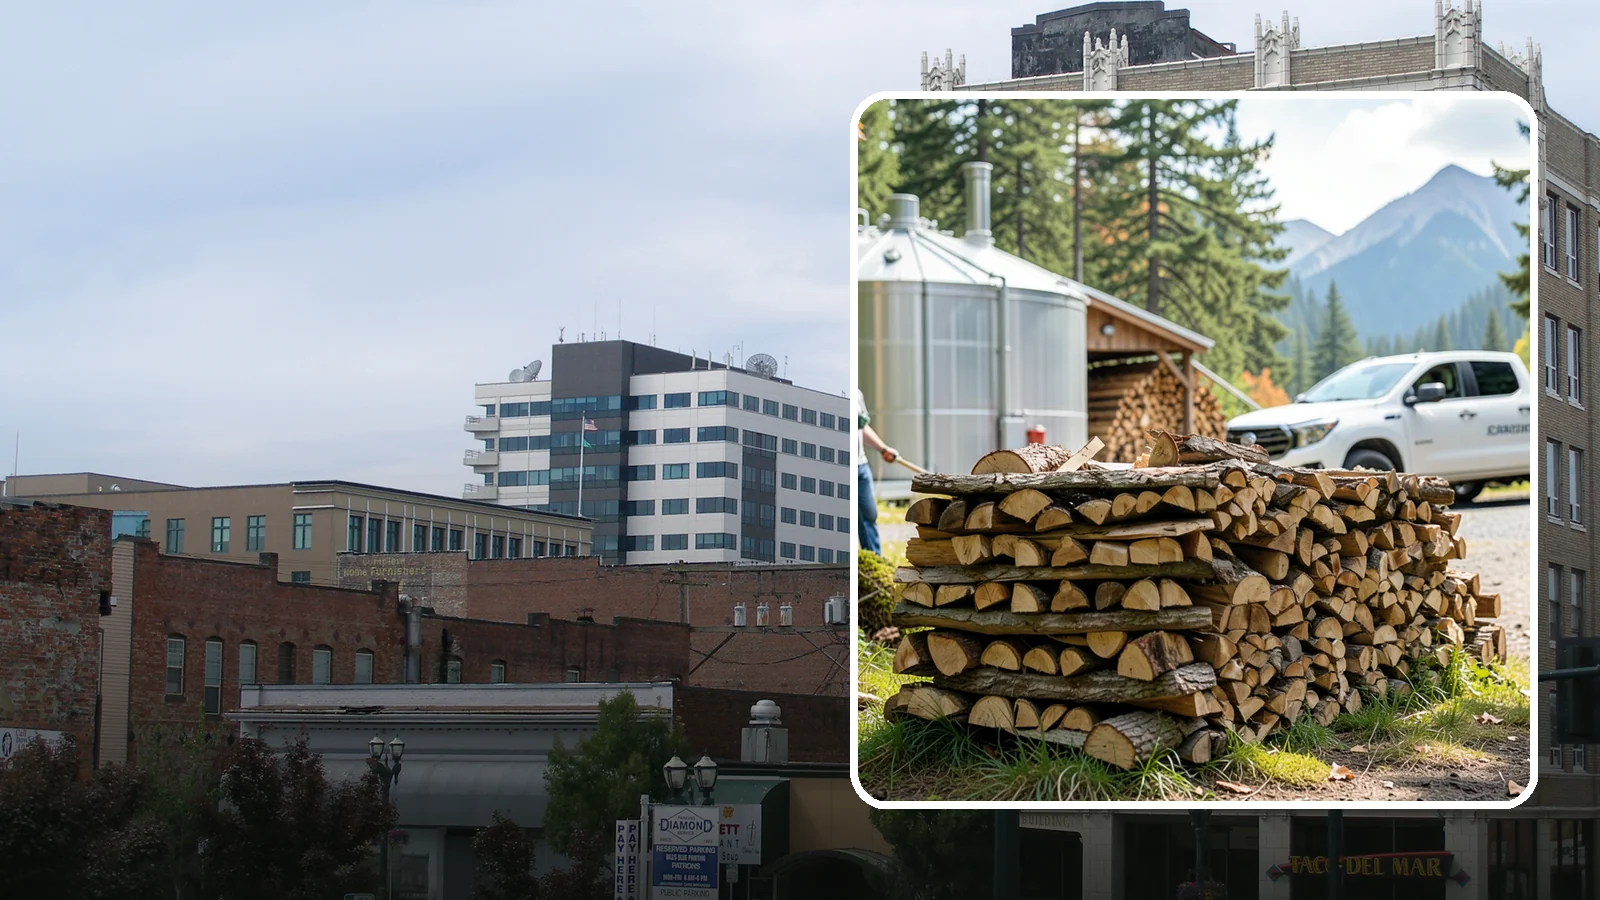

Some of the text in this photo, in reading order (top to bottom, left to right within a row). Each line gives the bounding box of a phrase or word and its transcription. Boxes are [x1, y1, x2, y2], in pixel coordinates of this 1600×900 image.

[343, 567, 368, 577] Home
[660, 818, 713, 833] DIAMOND
[1022, 815, 1070, 828] BUILDING
[656, 845, 716, 854] RESERVED PARKING
[616, 824, 625, 894] PAY HERE
[627, 824, 637, 894] PAY HERE
[671, 862, 701, 870] PATRONS
[1346, 856, 1385, 876] DEL
[1392, 857, 1443, 877] MAR
[660, 888, 710, 899] PUBLIC PARKING
